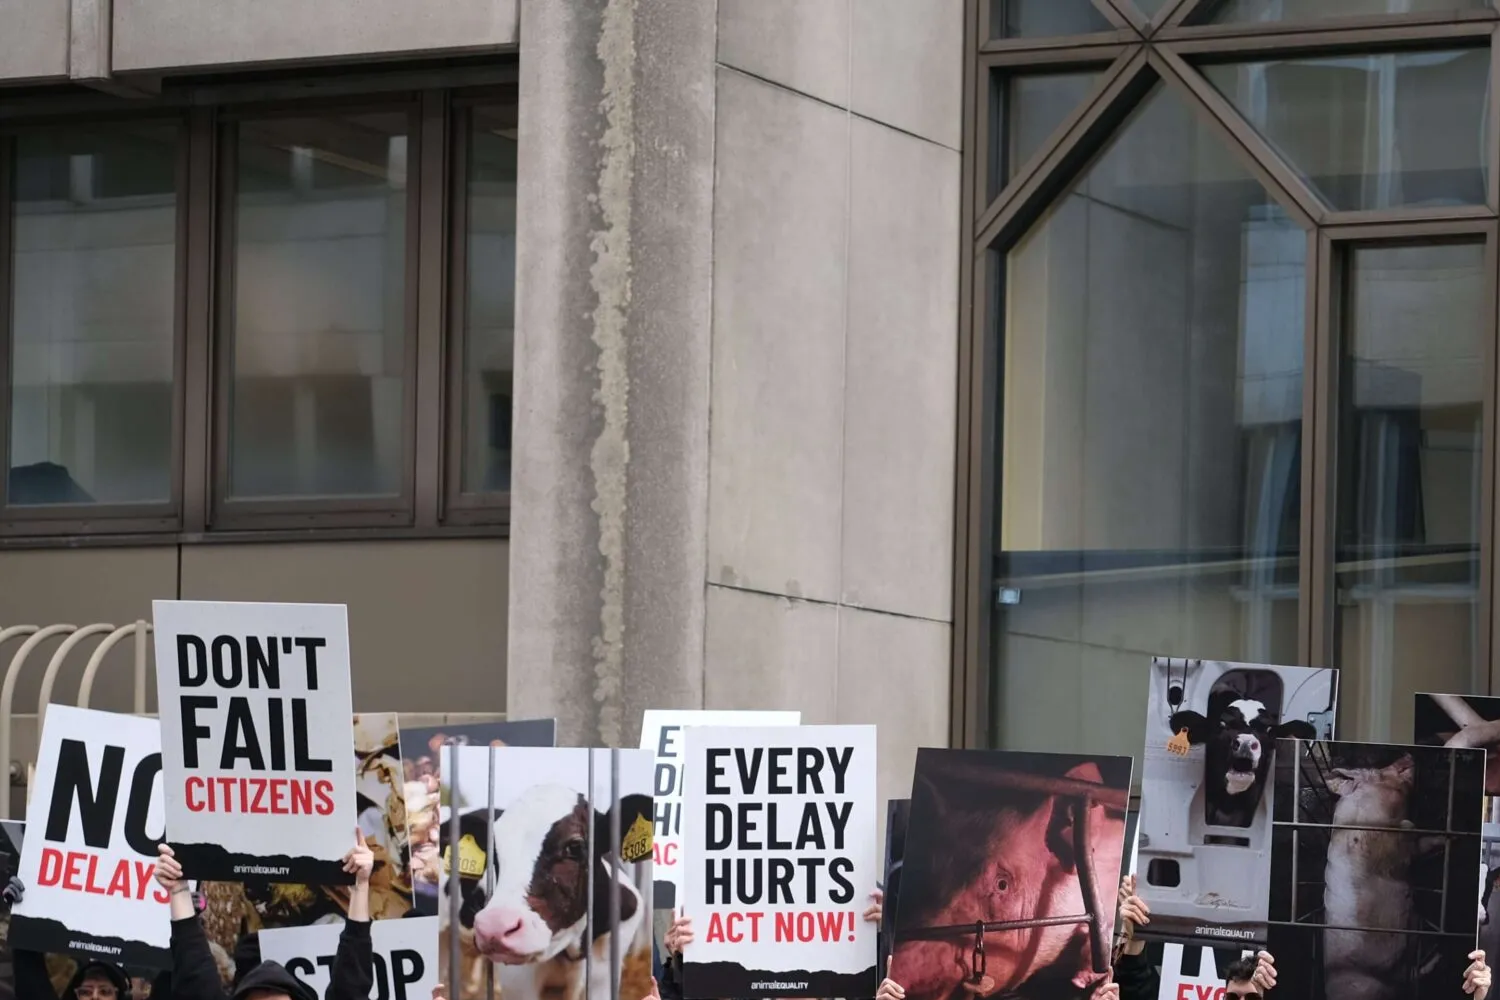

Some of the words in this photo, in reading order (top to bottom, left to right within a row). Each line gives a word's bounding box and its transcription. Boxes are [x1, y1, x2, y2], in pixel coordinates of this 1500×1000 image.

[176, 634, 327, 690] DON'T
[179, 695, 333, 772] FAIL
[705, 746, 855, 796] EVERY
[185, 776, 335, 816] CITIZENS
[705, 802, 854, 851] DELAY
[705, 857, 856, 906] HURTS
[706, 912, 763, 943] ACT
[775, 912, 856, 943] NOW!
[1195, 924, 1256, 939] animalEQUALITY
[751, 980, 809, 990] animalEQUALITY
